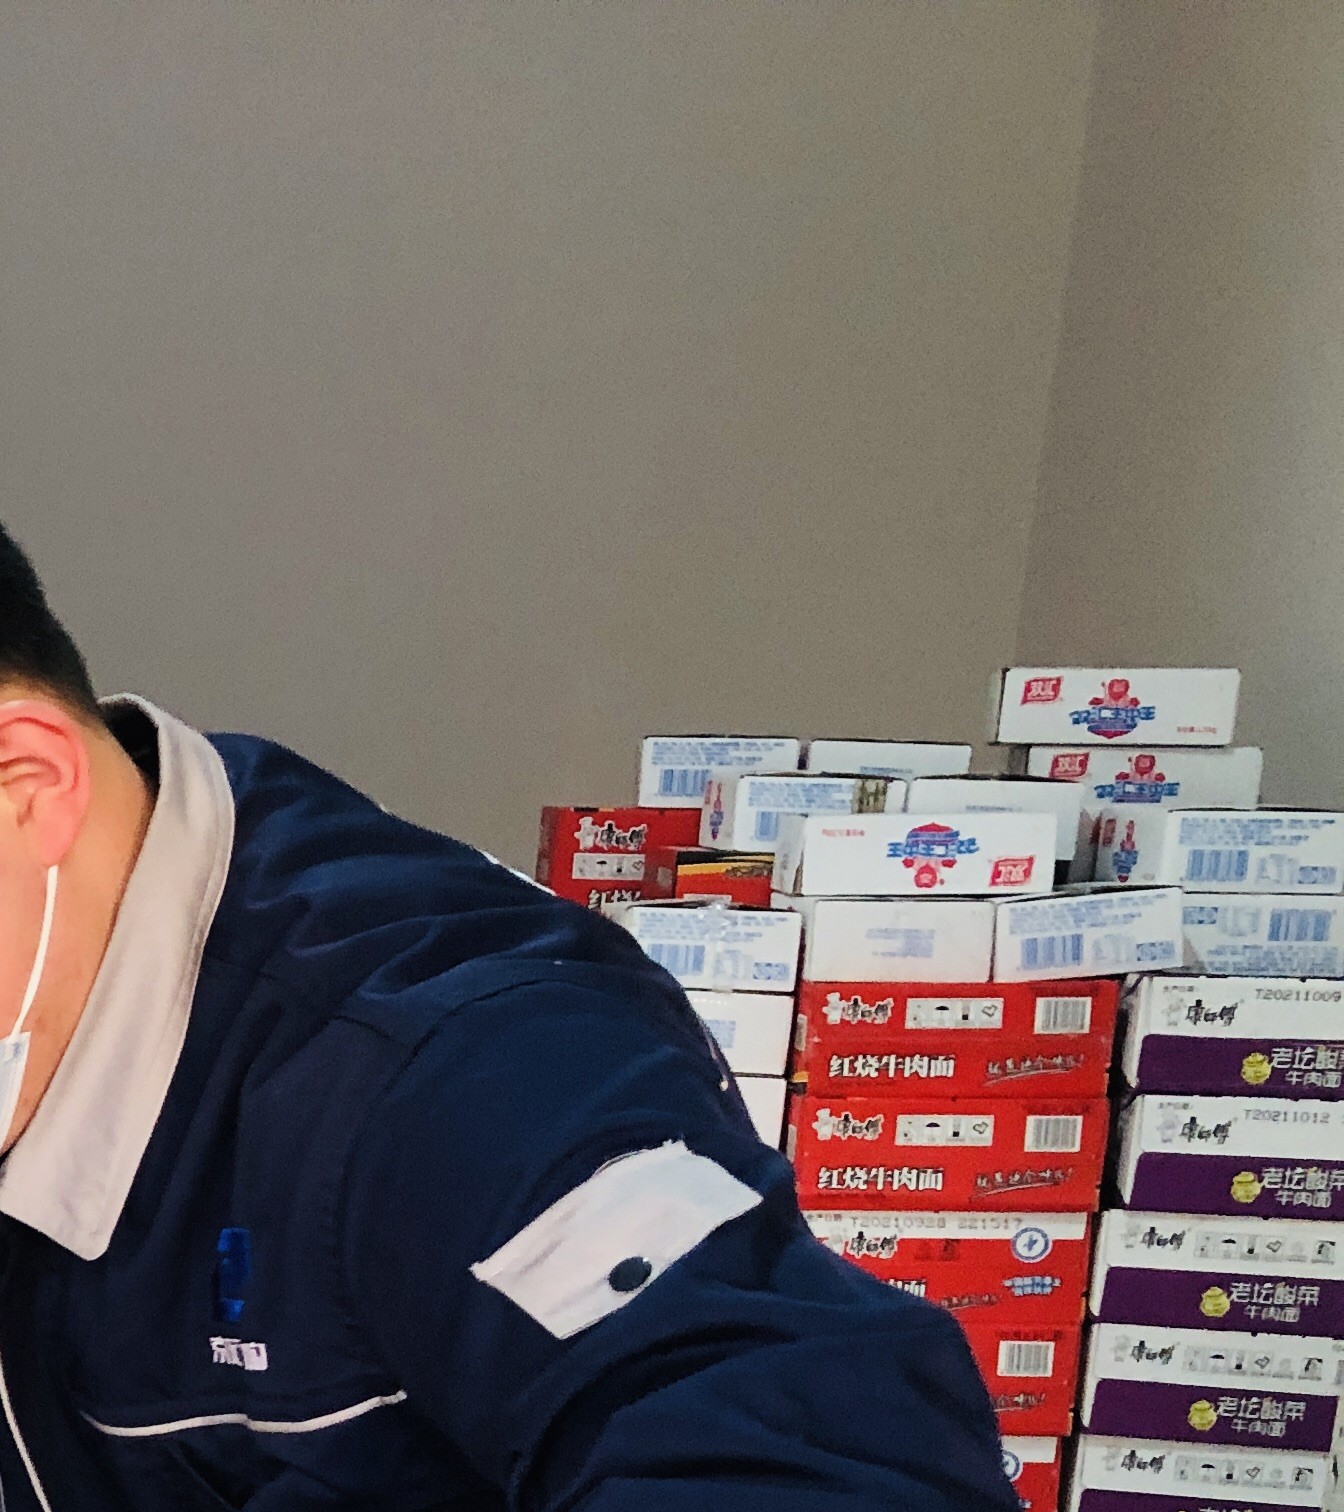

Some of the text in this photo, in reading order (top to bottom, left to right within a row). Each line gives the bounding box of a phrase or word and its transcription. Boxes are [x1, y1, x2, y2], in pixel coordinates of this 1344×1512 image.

[829, 1054, 956, 1078] 红烧牛肉面
[1270, 1046, 1344, 1070] 老坛酸
[1285, 1070, 1342, 1088] 牛肉面
[818, 1167, 945, 1191] 红烧牛肉面
[1274, 1190, 1332, 1209] 牛肉面
[1230, 1281, 1321, 1306] 老坛酸菜
